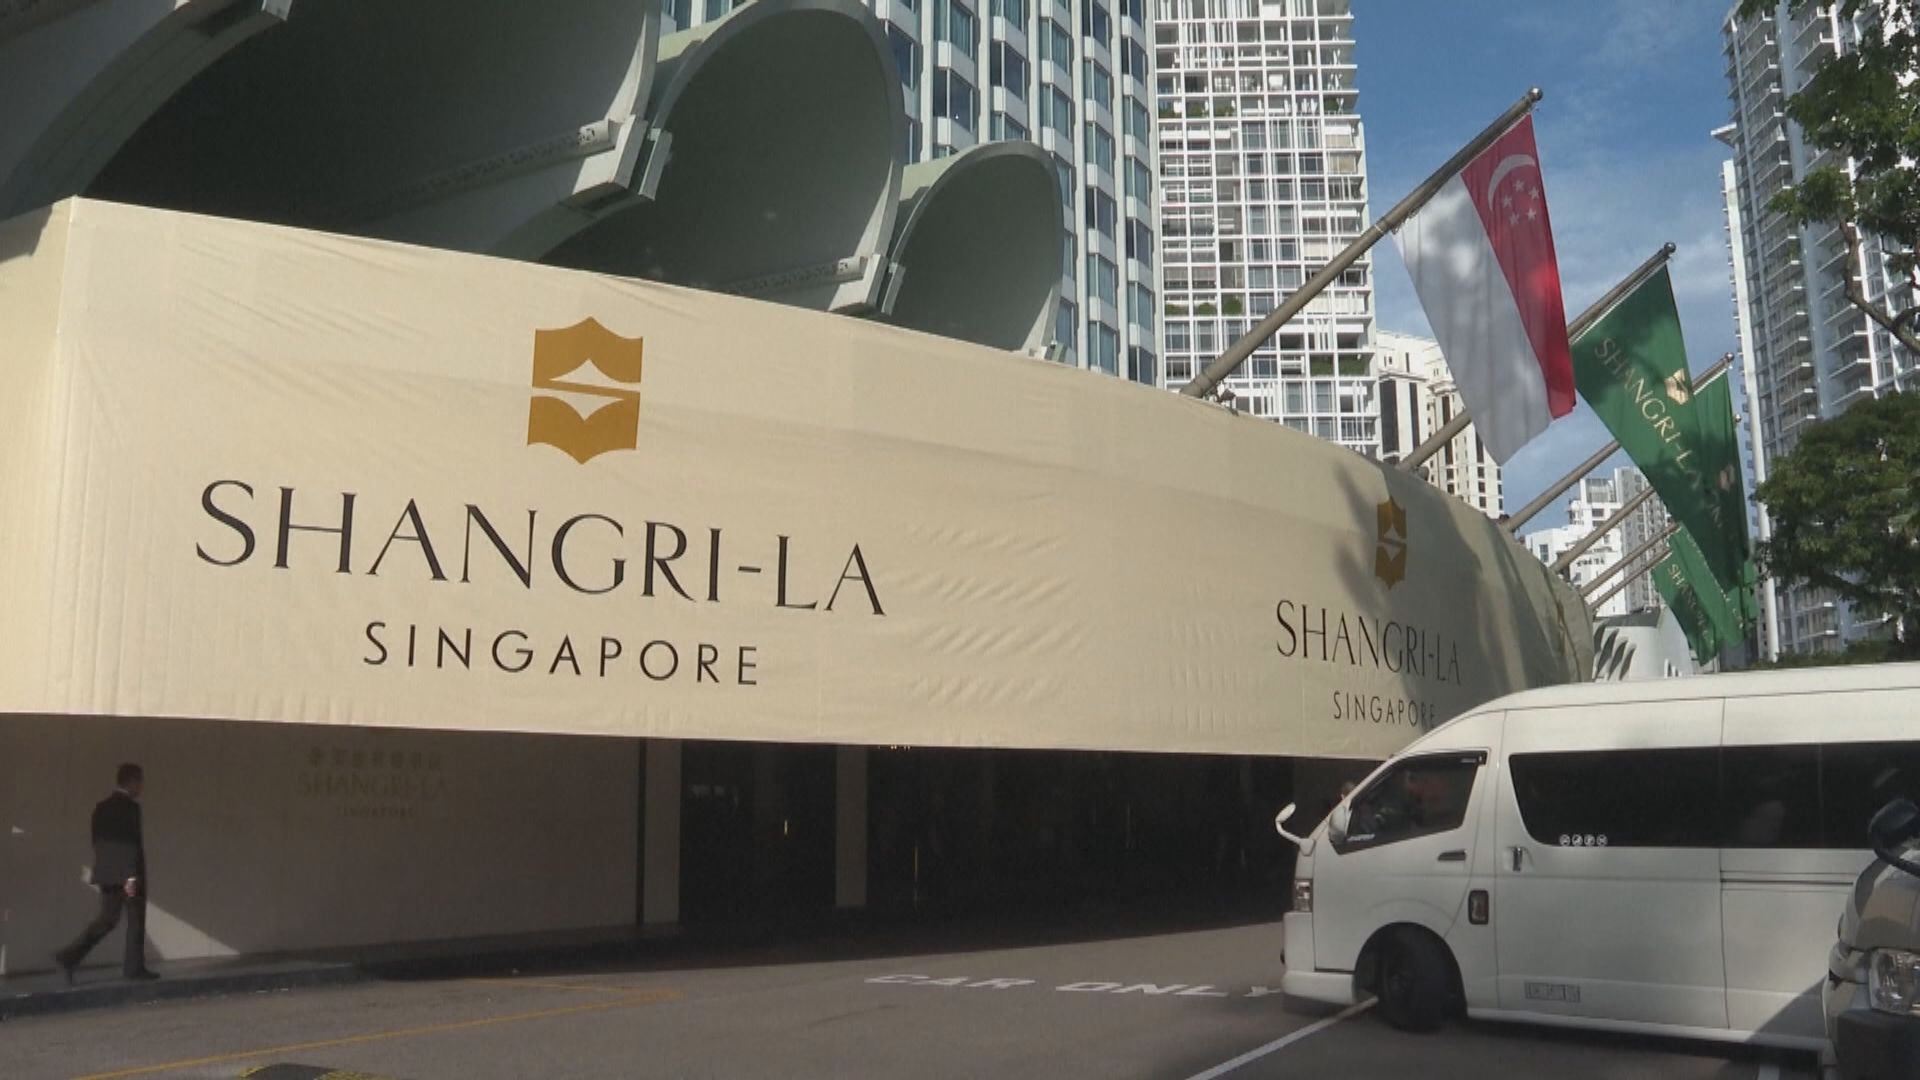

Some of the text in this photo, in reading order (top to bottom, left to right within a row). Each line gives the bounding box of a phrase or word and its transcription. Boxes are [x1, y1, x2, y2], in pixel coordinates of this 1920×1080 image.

[196, 479, 886, 616] SHANGRI-LA
[363, 621, 758, 686] SINGAPORE
[1276, 599, 1461, 686] SHANGRI-LA
[1333, 690, 1436, 730] SINGAPORE
[864, 973, 1036, 990] CAR
